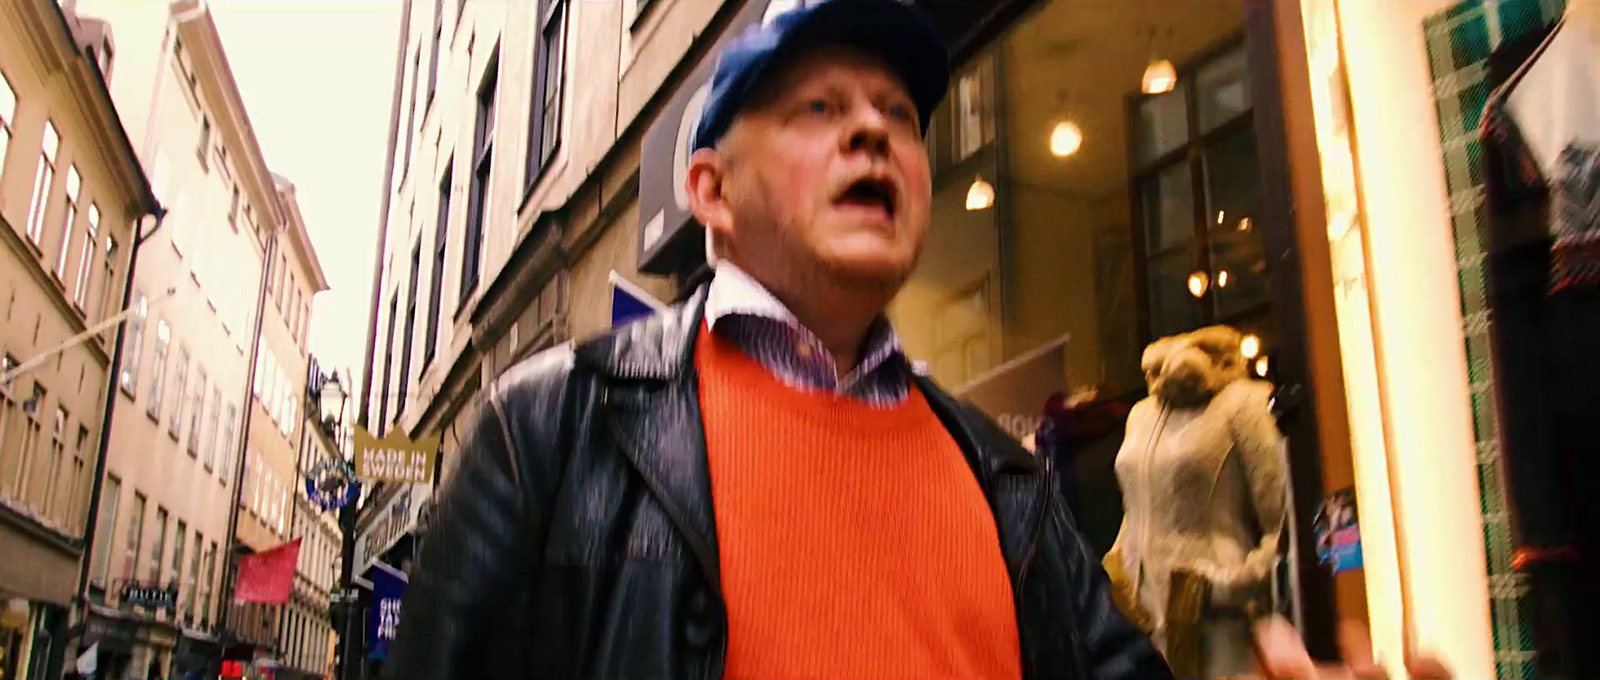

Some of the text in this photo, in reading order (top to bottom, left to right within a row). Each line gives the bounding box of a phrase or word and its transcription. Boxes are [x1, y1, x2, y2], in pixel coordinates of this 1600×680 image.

[363, 446, 426, 466] MADE IN
[362, 460, 426, 481] SWEDEN
